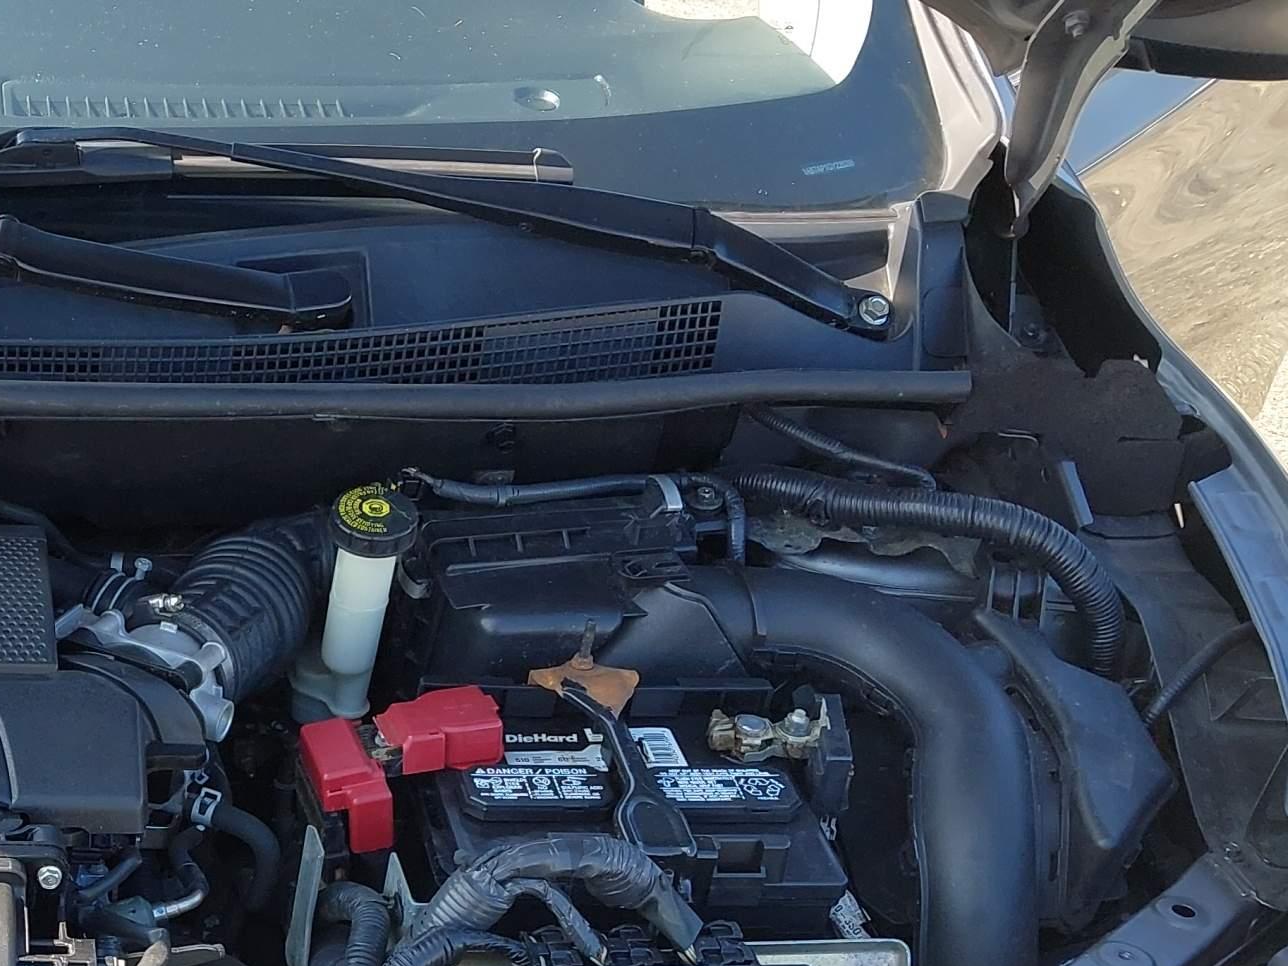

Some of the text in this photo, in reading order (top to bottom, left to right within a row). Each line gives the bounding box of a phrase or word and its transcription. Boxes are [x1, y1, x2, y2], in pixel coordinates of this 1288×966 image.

[504, 733, 578, 743] DieHard
[486, 767, 534, 775] DANGER
[544, 767, 588, 775] POISON
